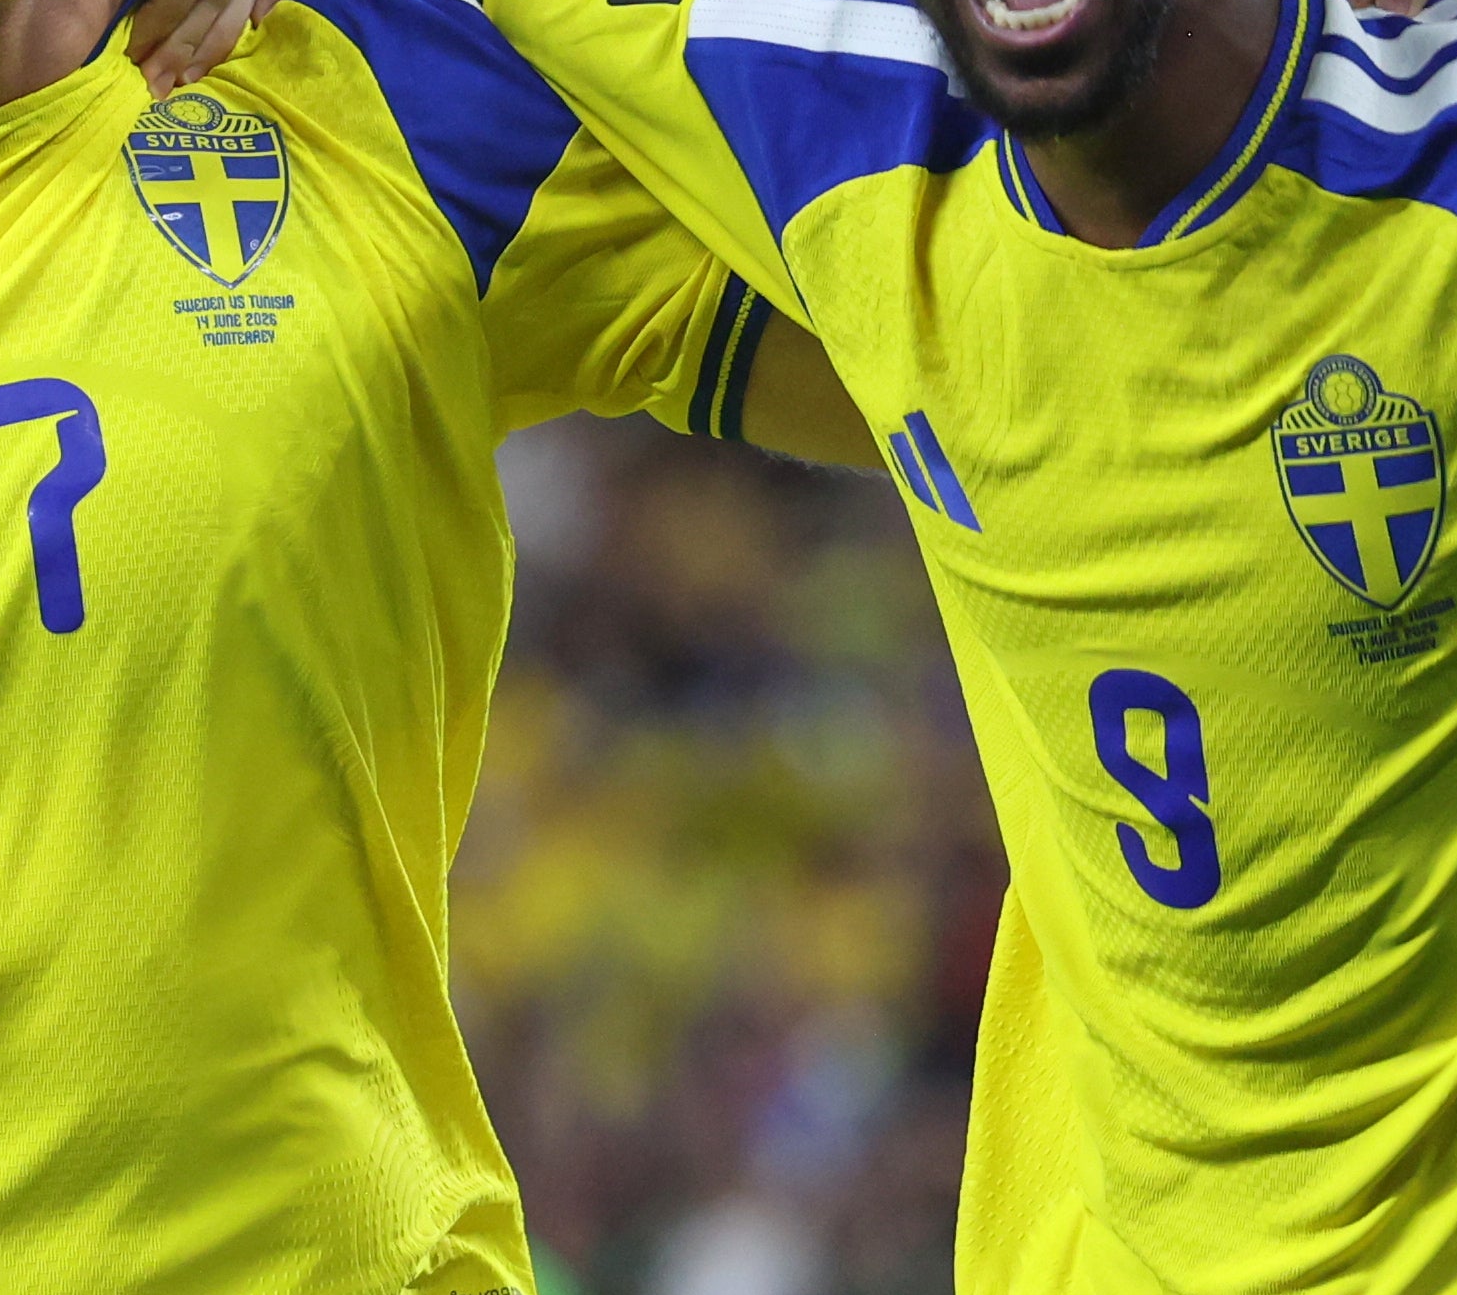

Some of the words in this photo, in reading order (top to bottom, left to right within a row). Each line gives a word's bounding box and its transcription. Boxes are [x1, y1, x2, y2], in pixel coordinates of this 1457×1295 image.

[145, 134, 256, 151] SVERIGE
[173, 296, 225, 314] SWEDEN
[249, 294, 295, 310] TUNISIA
[196, 315, 209, 329] 14
[214, 313, 242, 328] JUNE
[245, 312, 277, 326] 2026
[203, 330, 275, 347] MONTERREY
[1296, 427, 1410, 455] SVERIGE
[1088, 668, 1221, 909] 9
